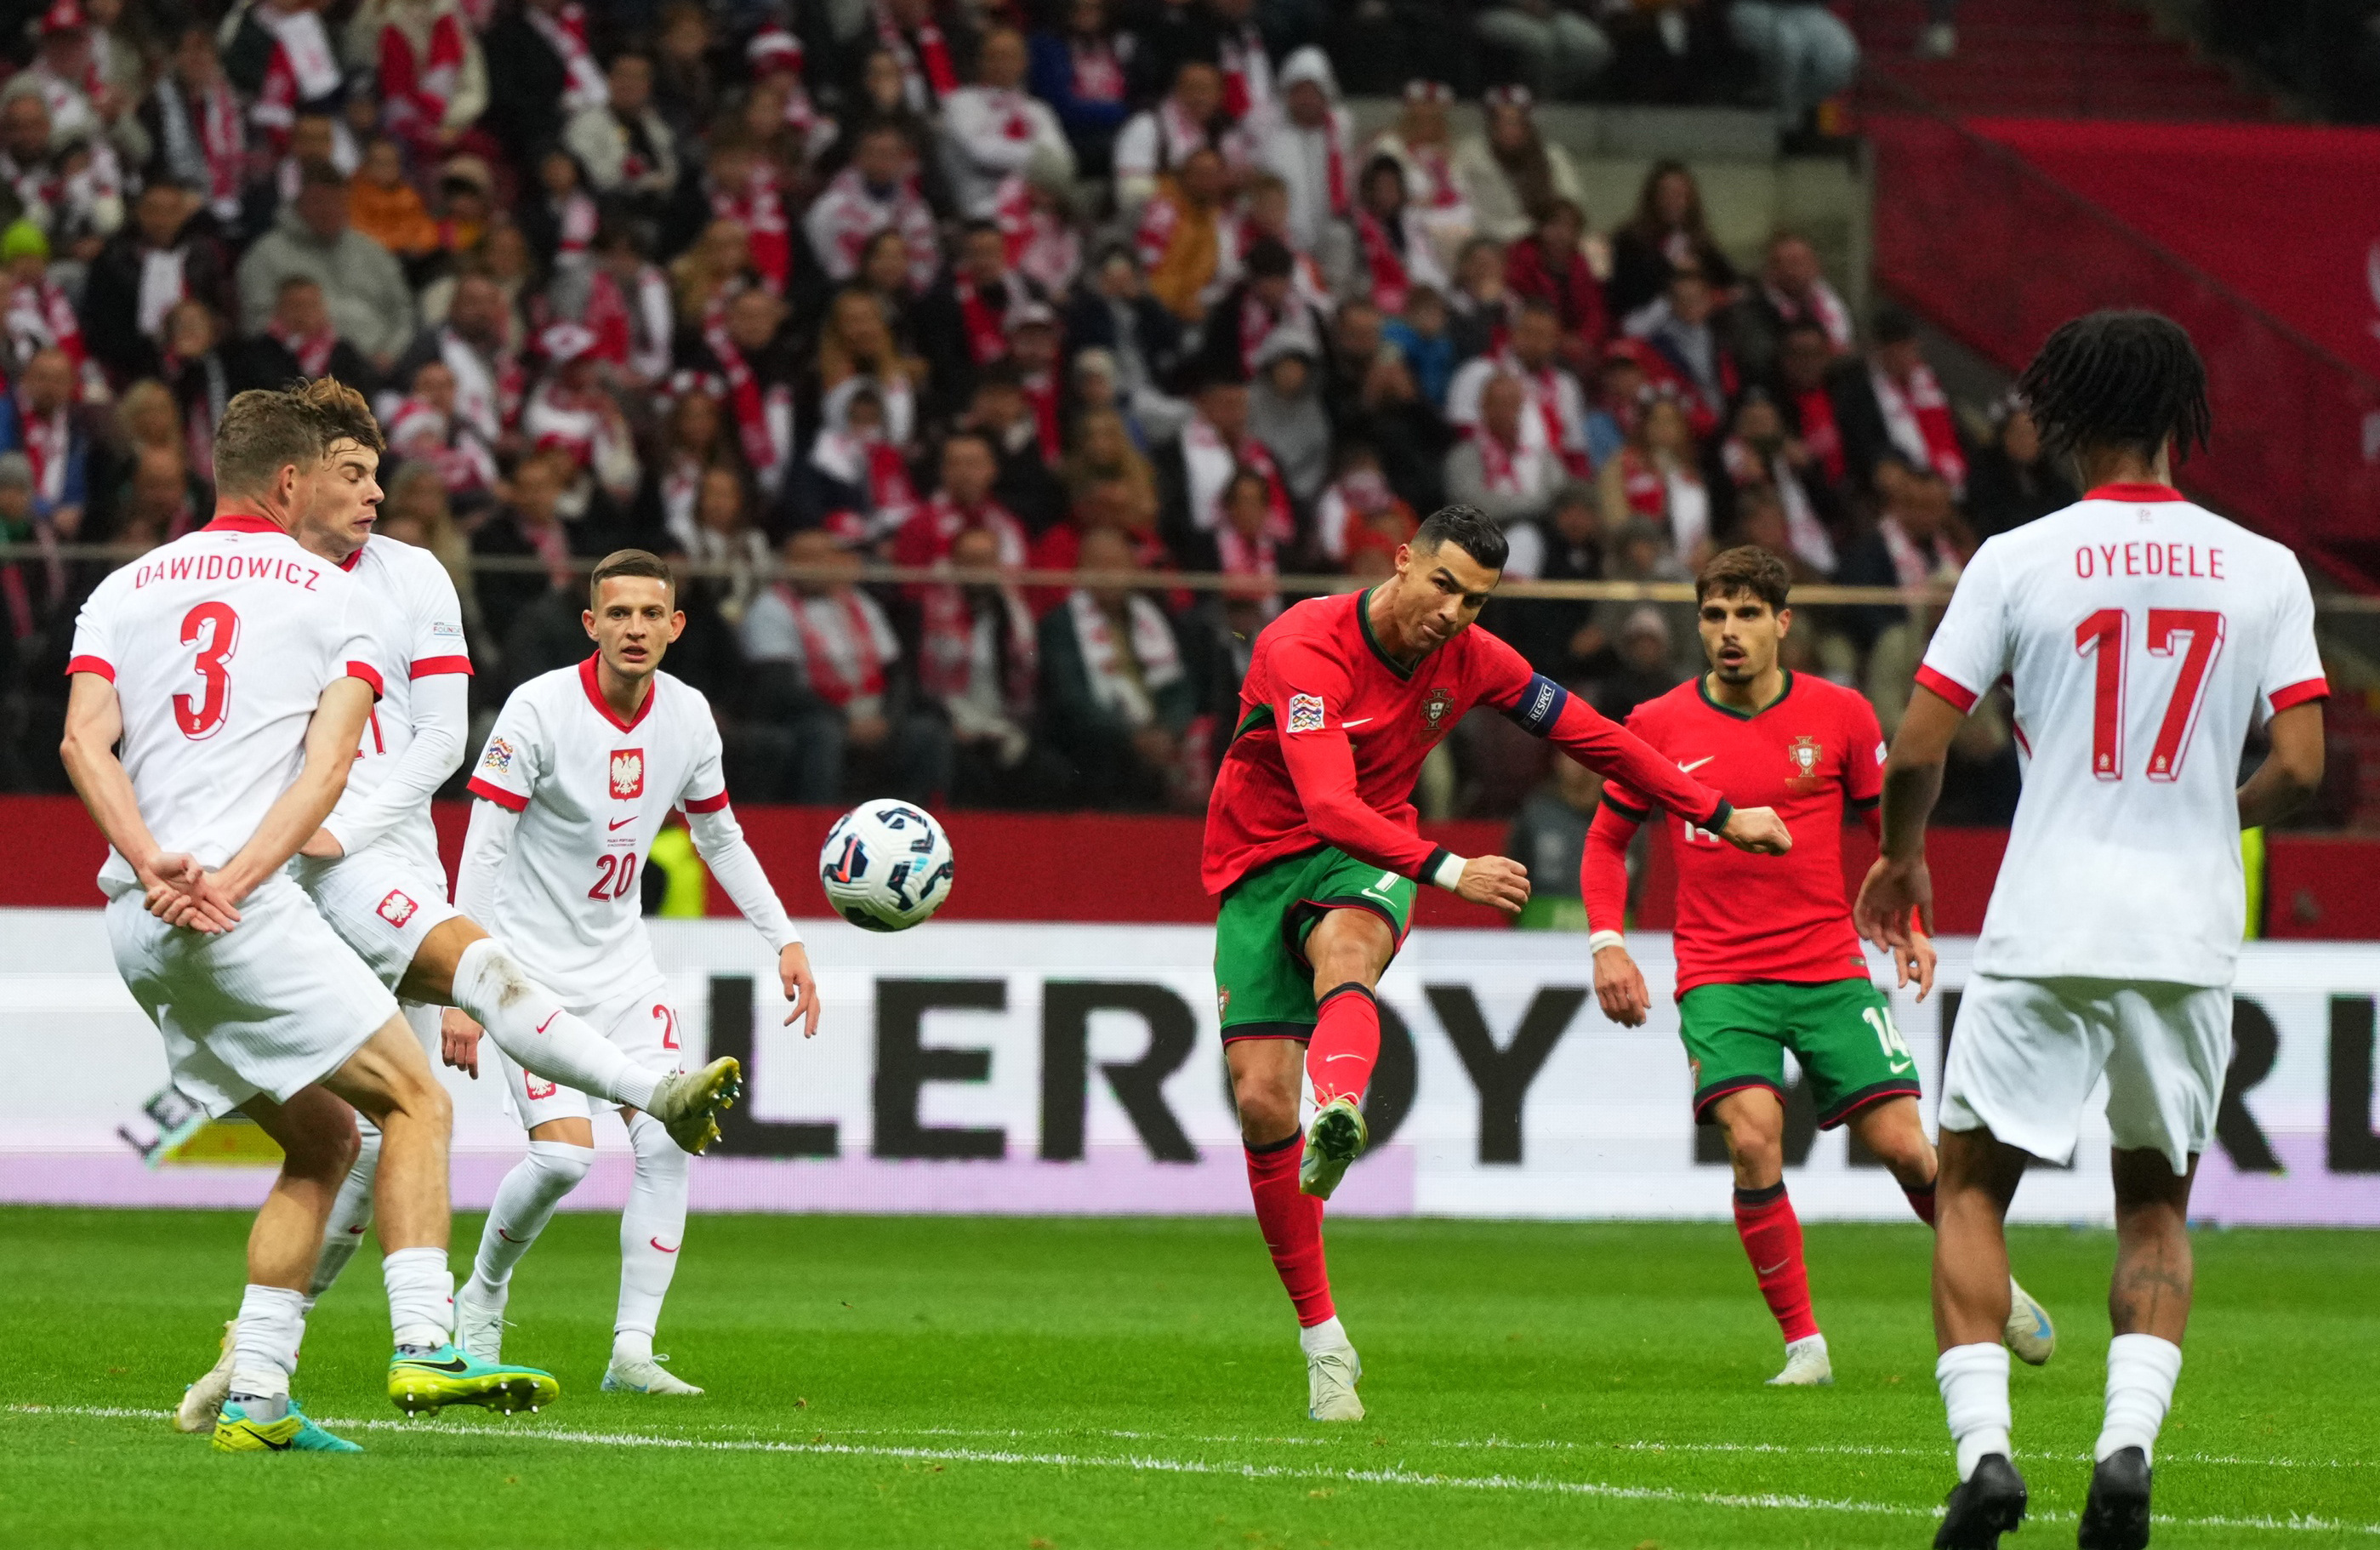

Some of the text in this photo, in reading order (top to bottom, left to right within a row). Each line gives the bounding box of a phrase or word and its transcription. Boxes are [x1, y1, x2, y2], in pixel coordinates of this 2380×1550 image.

[135, 555, 320, 592] DAWIDOWICZ
[2075, 541, 2225, 579] OYEDELE
[173, 601, 240, 741] 3
[2075, 607, 2226, 782] 17
[1530, 684, 1552, 721] RESPECT
[588, 852, 637, 903] 20
[652, 1004, 682, 1052] 2
[1862, 1006, 1910, 1057] 14
